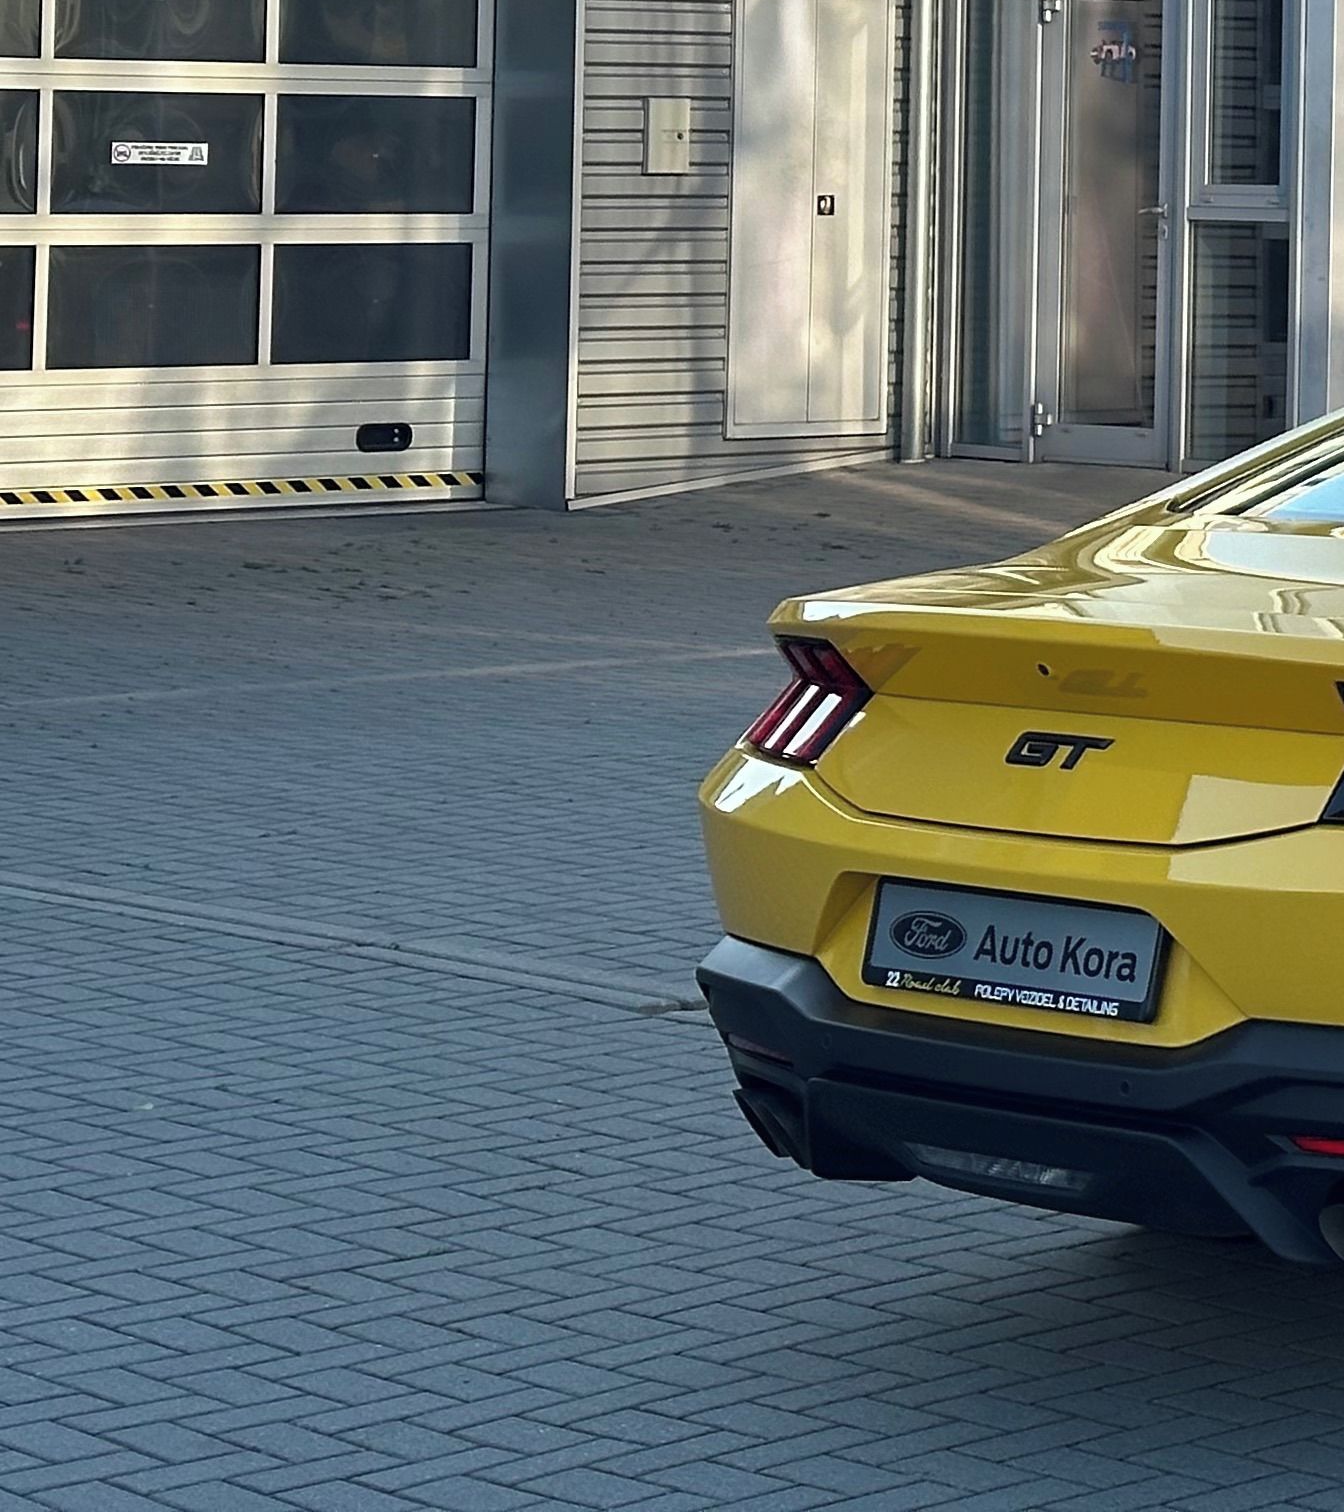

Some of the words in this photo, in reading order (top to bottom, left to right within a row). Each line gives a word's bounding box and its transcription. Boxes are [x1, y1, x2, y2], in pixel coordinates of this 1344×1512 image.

[1005, 731, 1115, 770] GT
[904, 917, 950, 952] Ford
[973, 924, 1053, 971] Auto
[1060, 935, 1137, 983] Kora
